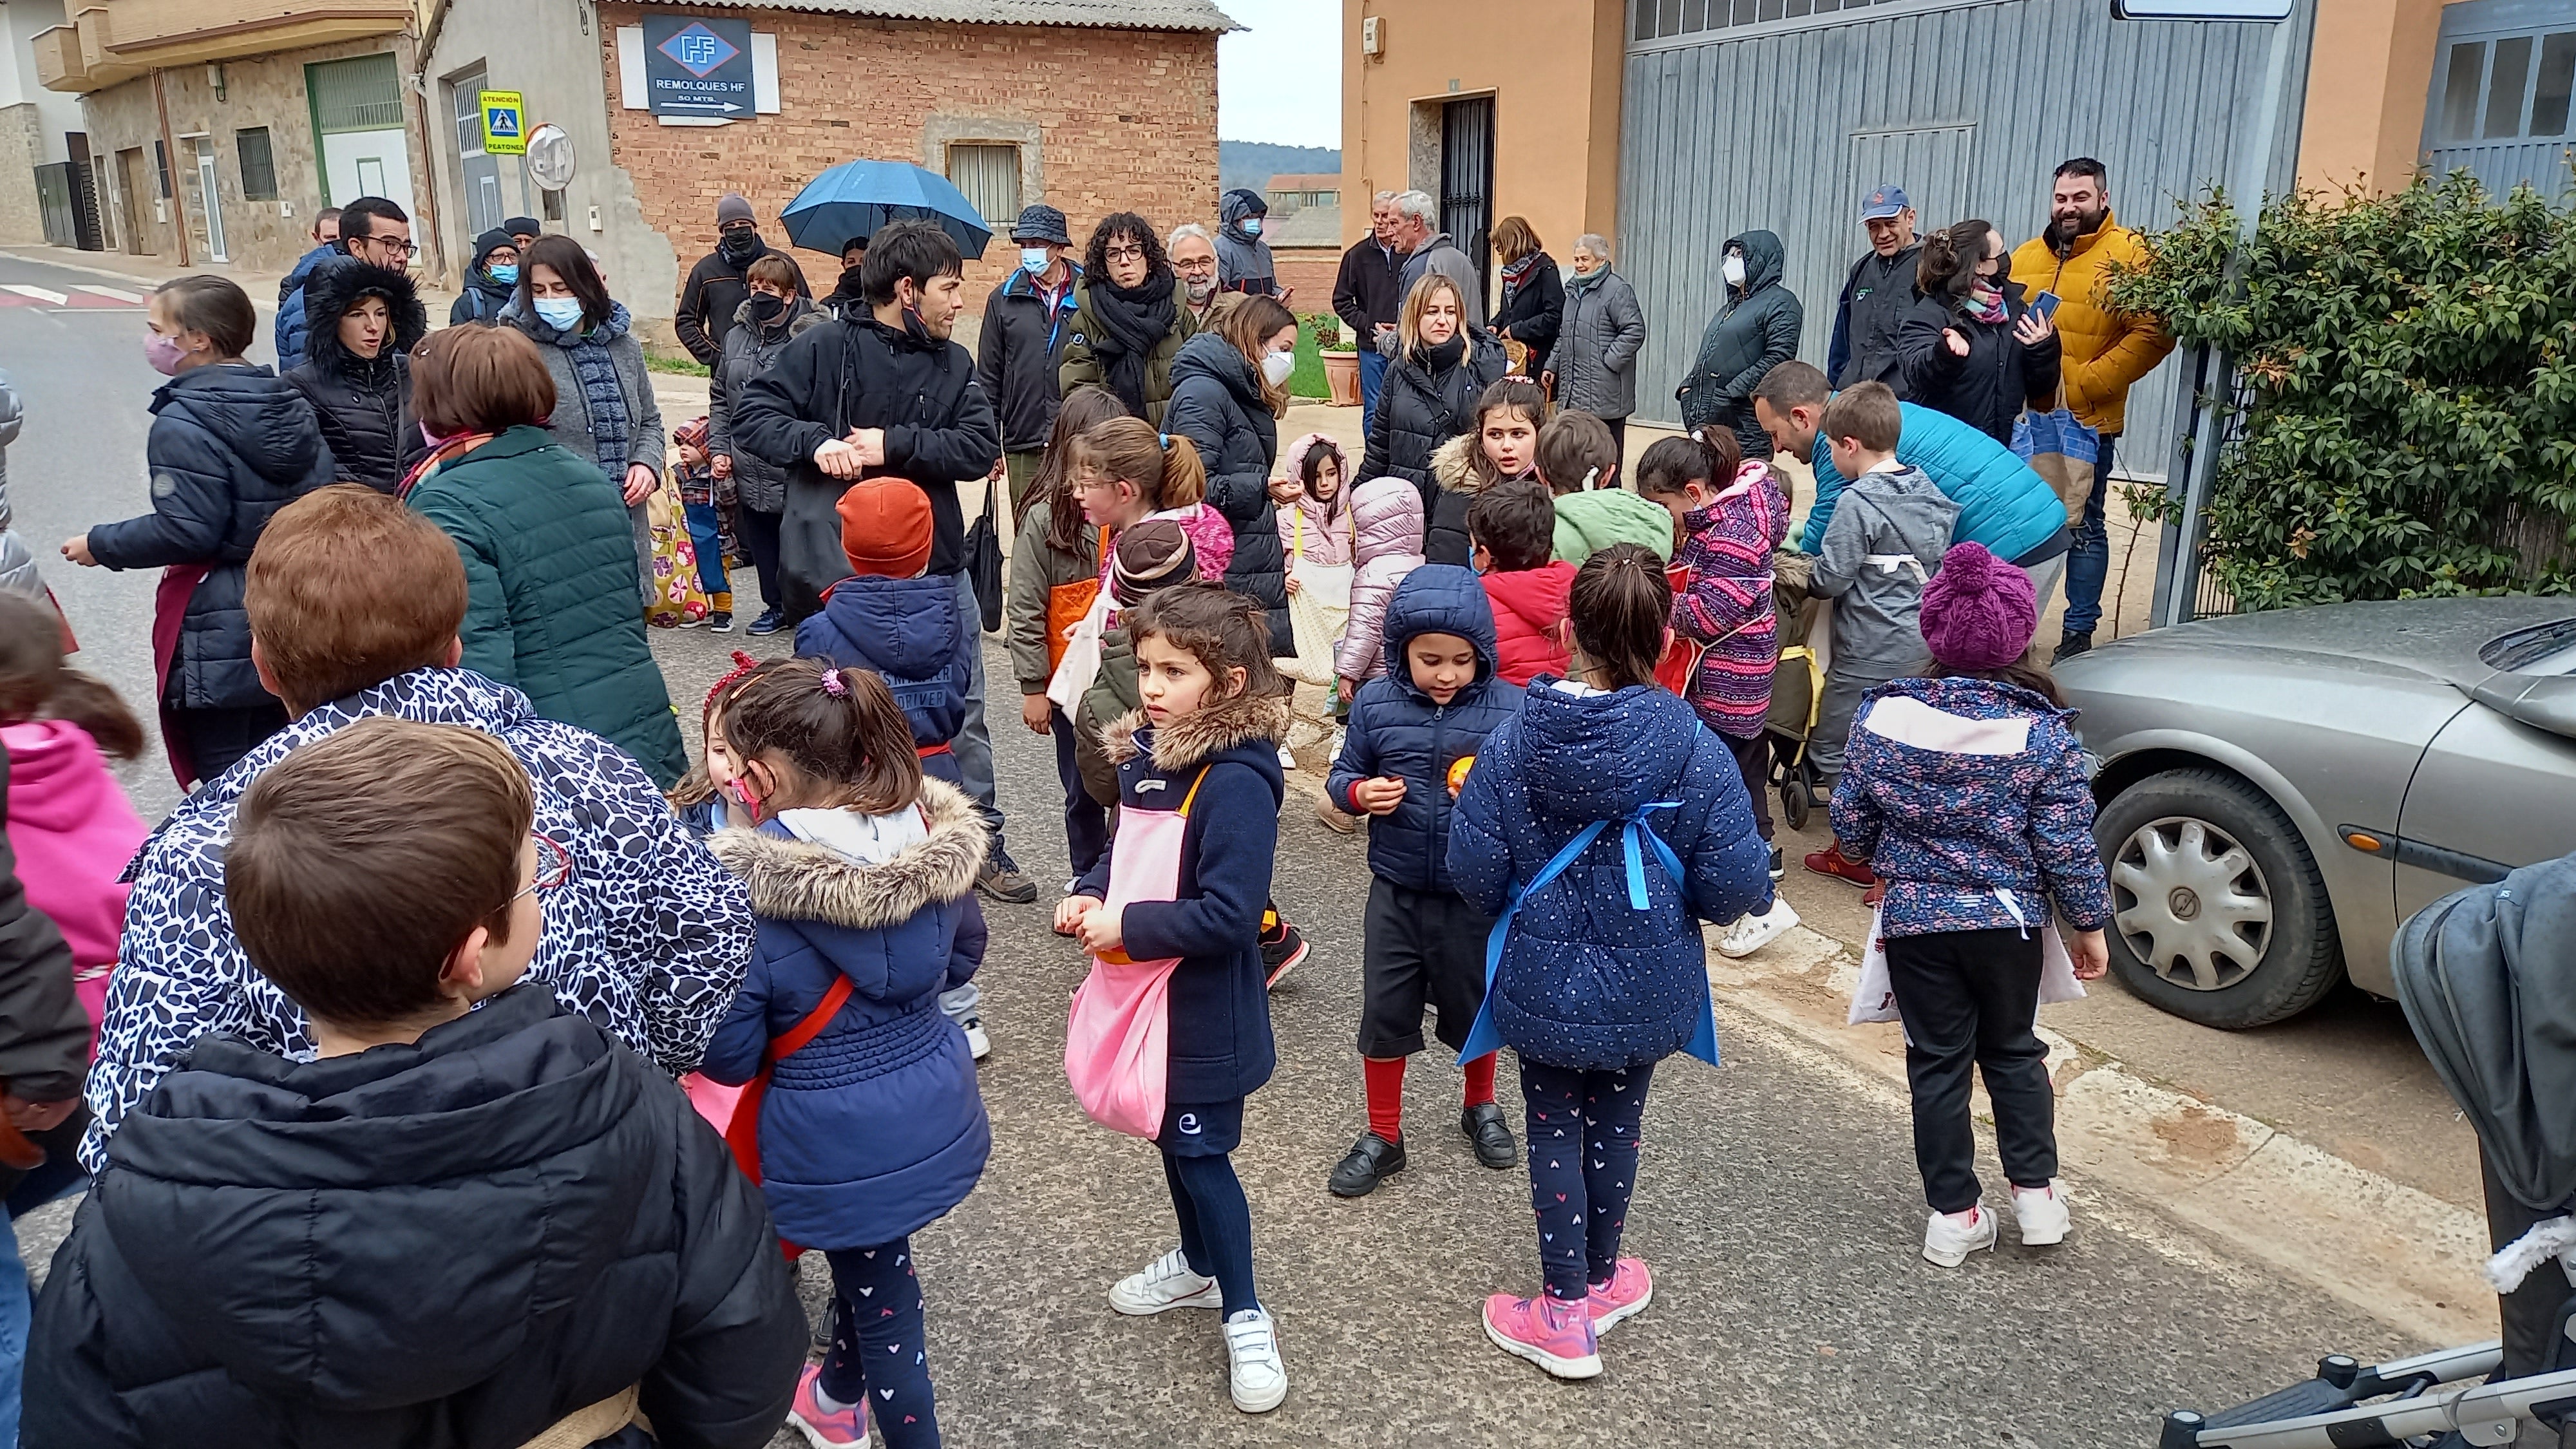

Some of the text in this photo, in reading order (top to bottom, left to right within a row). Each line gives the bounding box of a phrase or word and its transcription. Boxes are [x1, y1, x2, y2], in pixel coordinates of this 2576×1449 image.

[656, 79, 745, 92] REMOLQUES HF
[898, 692, 943, 709] DRIVER
